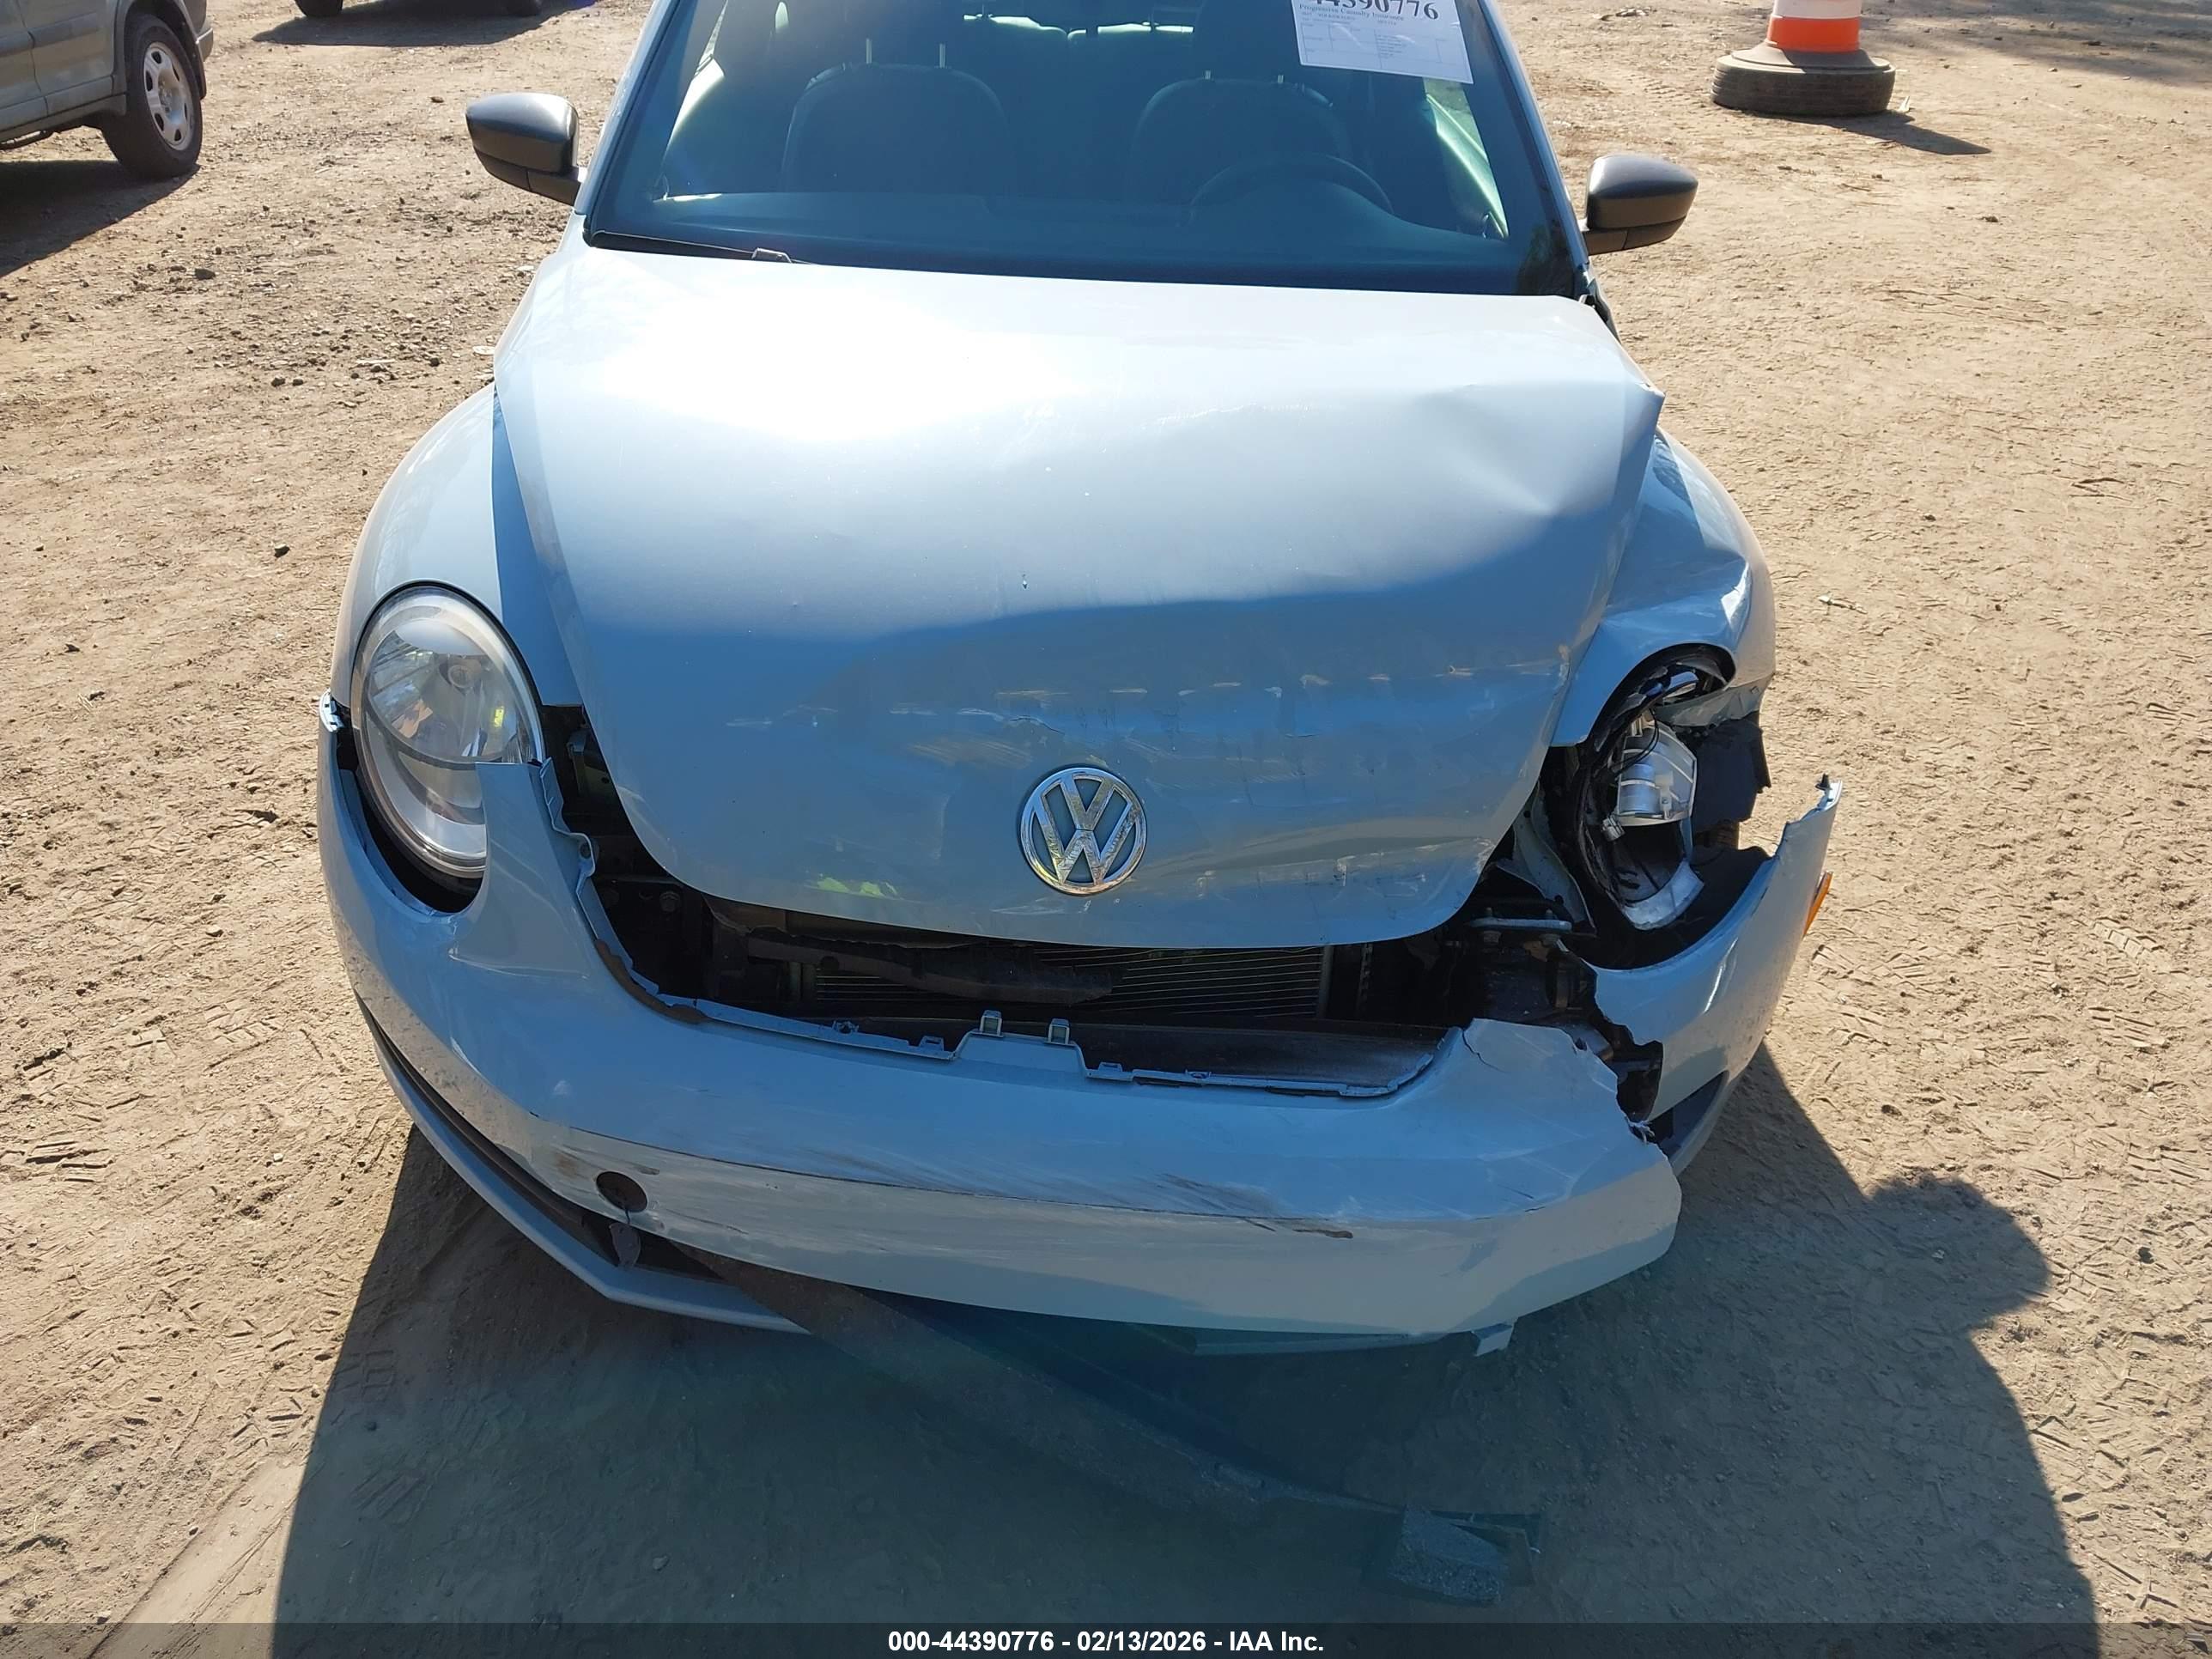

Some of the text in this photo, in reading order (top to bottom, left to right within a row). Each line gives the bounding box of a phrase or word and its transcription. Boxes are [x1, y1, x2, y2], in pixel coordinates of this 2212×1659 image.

[1299, 3, 1340, 14] Progressive
[1340, 8, 1370, 18] Casualty
[1372, 12, 1405, 21] Insurance
[1314, 0, 1439, 20] 90776
[1024, 771, 1143, 890] VW
